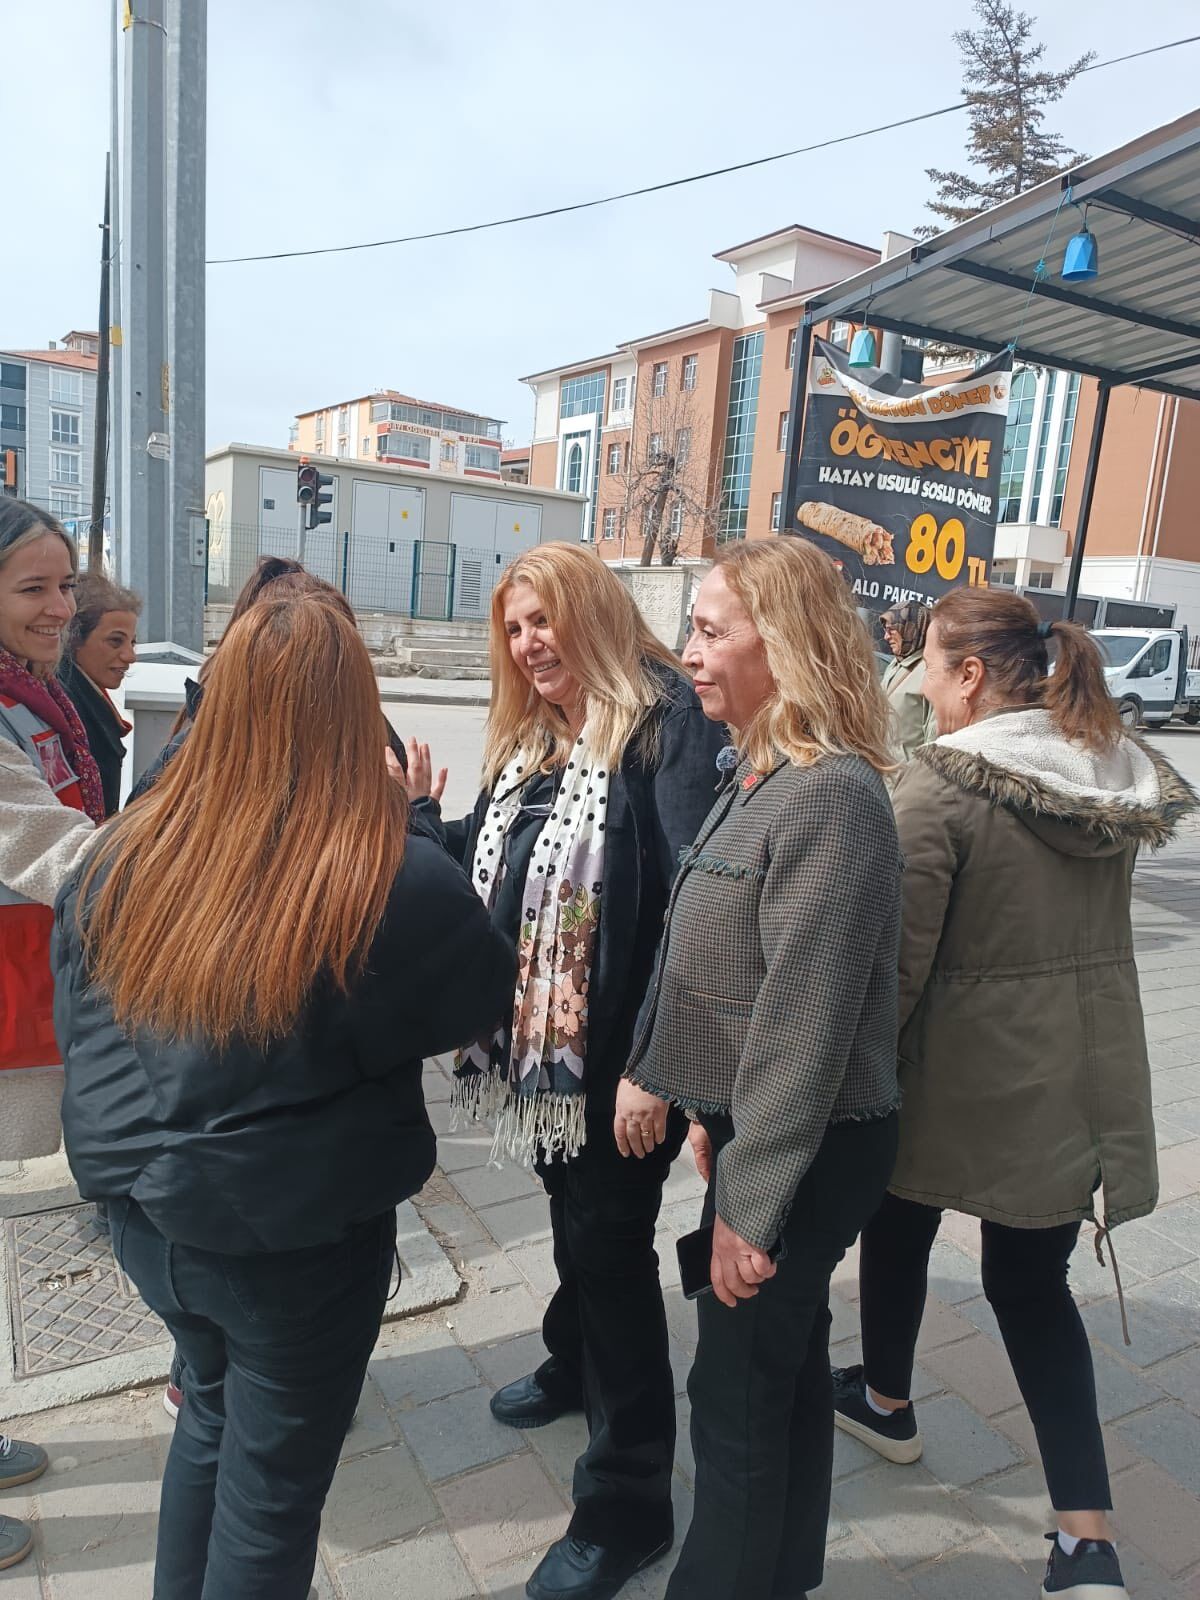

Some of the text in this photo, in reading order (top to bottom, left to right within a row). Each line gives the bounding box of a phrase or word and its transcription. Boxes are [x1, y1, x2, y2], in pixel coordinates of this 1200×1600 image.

[927, 384, 991, 415] DÖNER
[818, 466, 992, 515] HATAY USULÜ SOSLU DÖNER
[905, 512, 989, 587] 80 TL
[851, 578, 880, 598] ALO
[882, 584, 924, 603] PAKET
